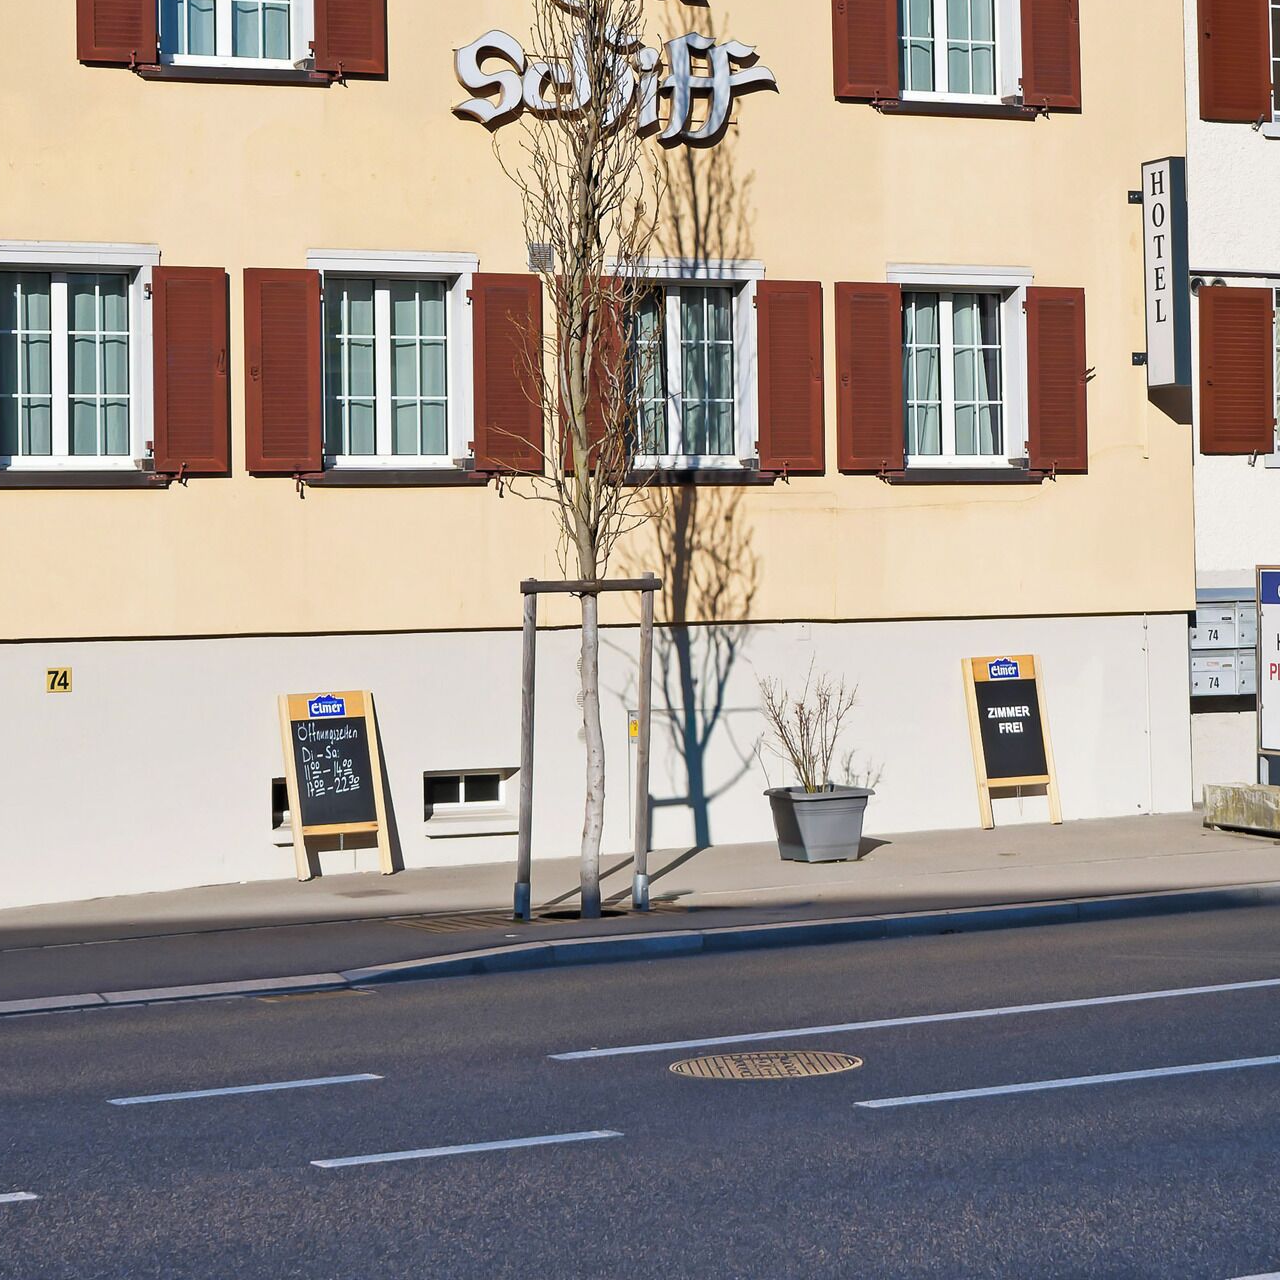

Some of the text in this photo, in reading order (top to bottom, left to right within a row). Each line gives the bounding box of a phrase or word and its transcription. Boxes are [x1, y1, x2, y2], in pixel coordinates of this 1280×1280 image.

[1149, 170, 1167, 323] HOTEL
[1208, 629, 1219, 641] 74
[991, 665, 1016, 676] Elmer
[47, 670, 69, 690] 74
[1209, 677, 1220, 689] 74
[311, 703, 342, 714] Elmer
[987, 706, 1030, 718] ZIMMER
[999, 722, 1023, 733] FREI
[302, 746, 314, 763] Di
